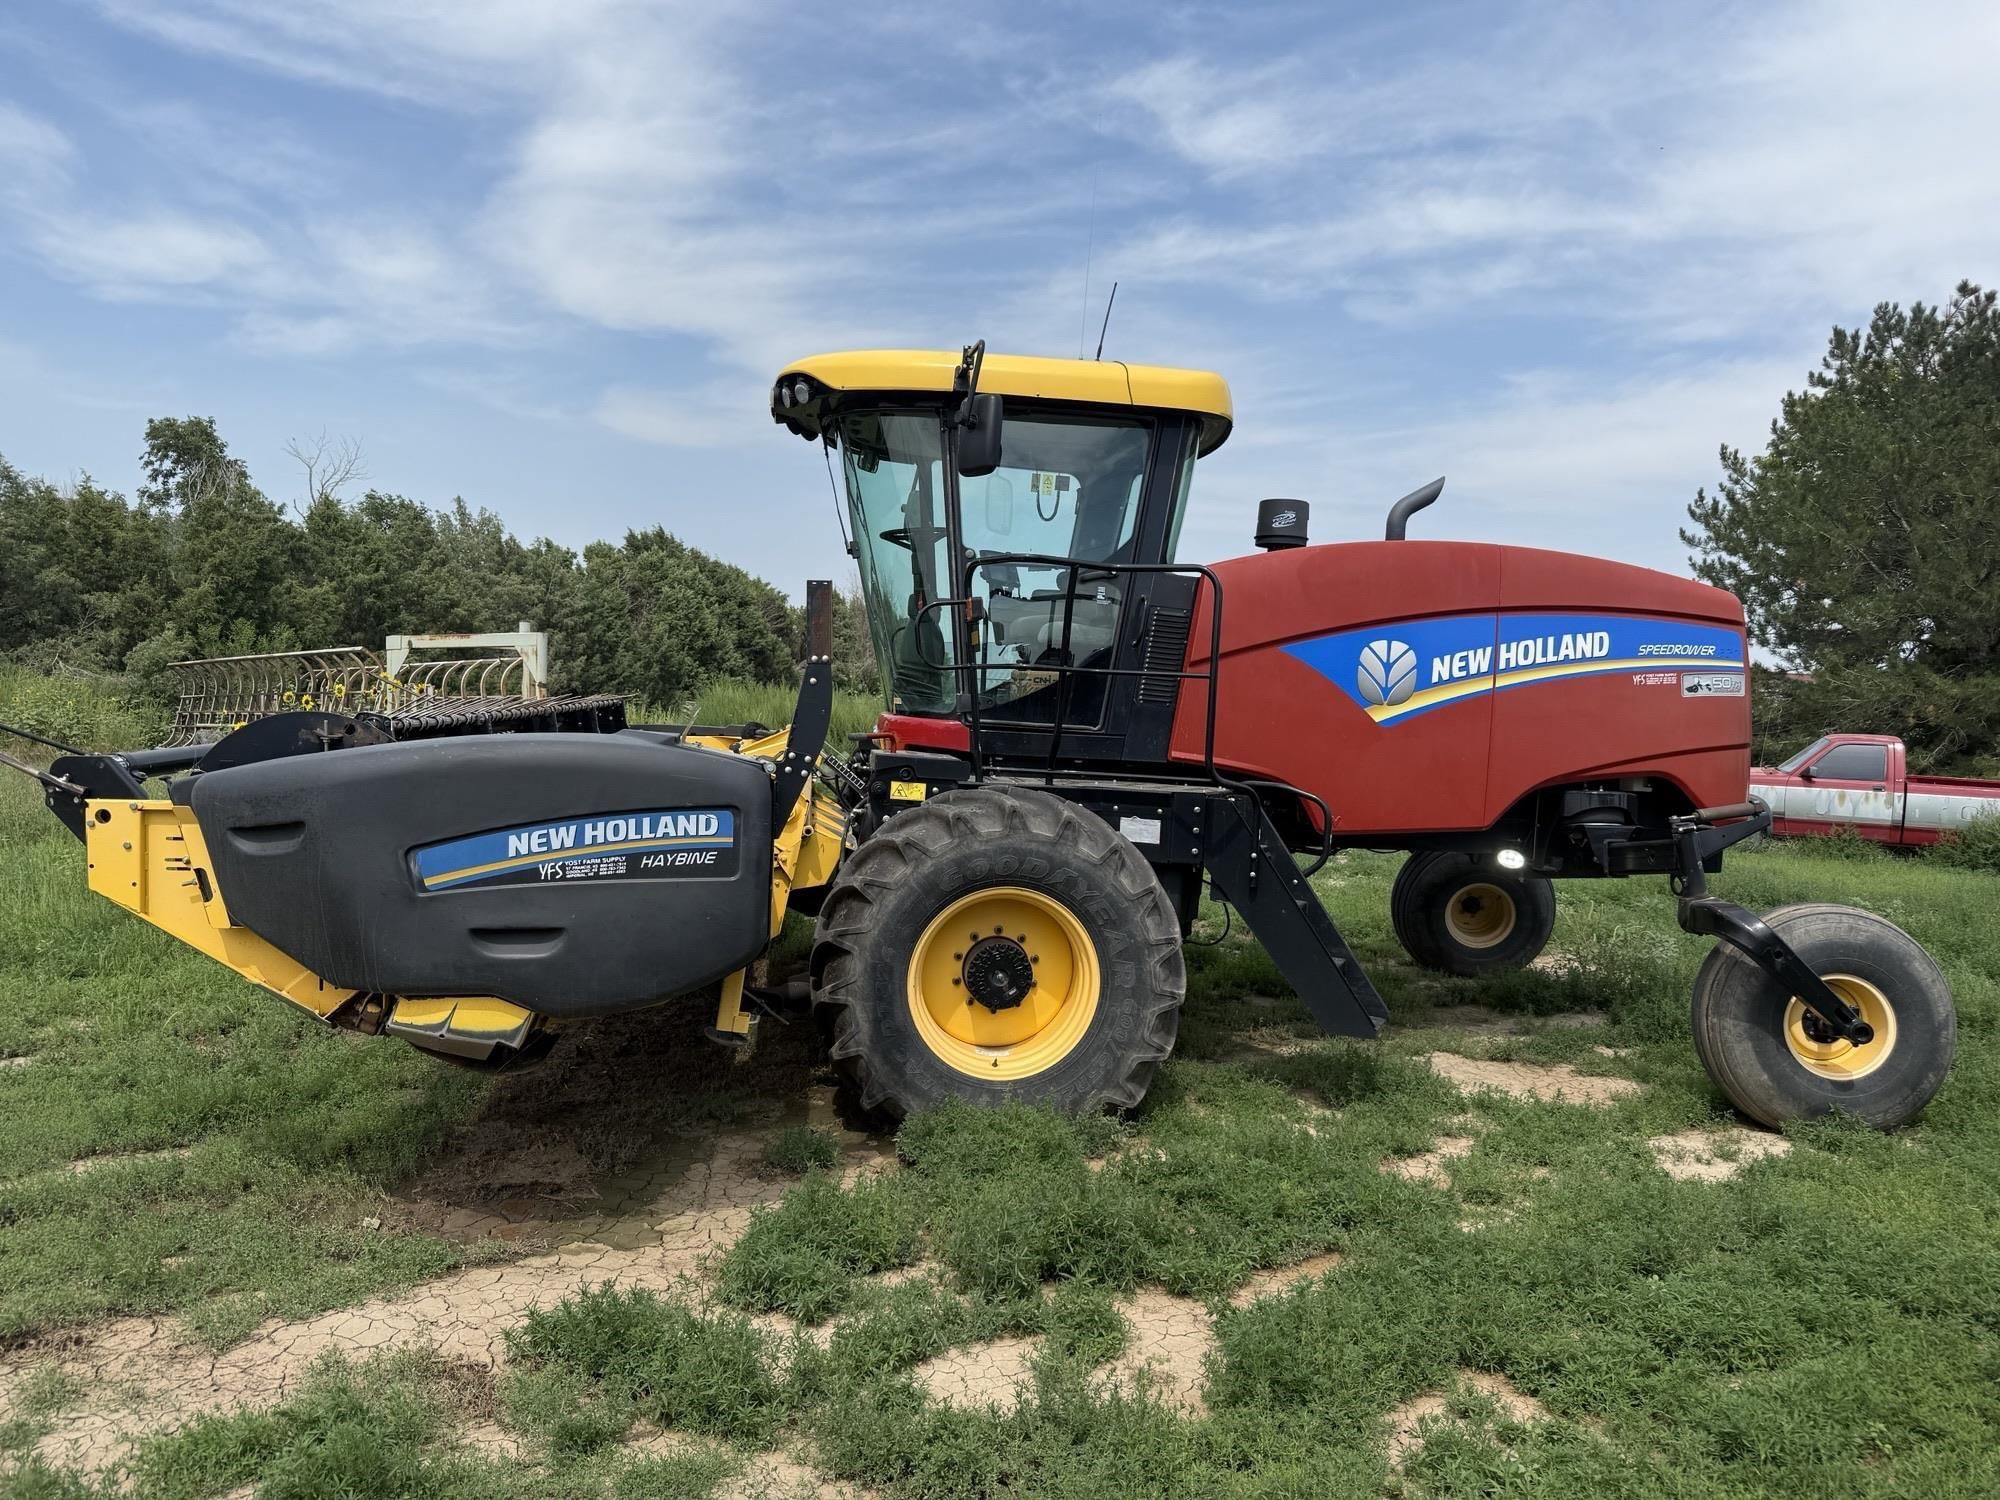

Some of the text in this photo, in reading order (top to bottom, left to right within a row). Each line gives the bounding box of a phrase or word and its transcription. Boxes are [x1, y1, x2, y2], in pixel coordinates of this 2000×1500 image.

[1431, 631, 1610, 683] NEW HOLLAND
[1638, 644, 1717, 656] SPEEDROWER
[508, 814, 719, 857] NEW HOLLAND
[641, 851, 718, 868] HAYBINE
[539, 861, 564, 880] YFS
